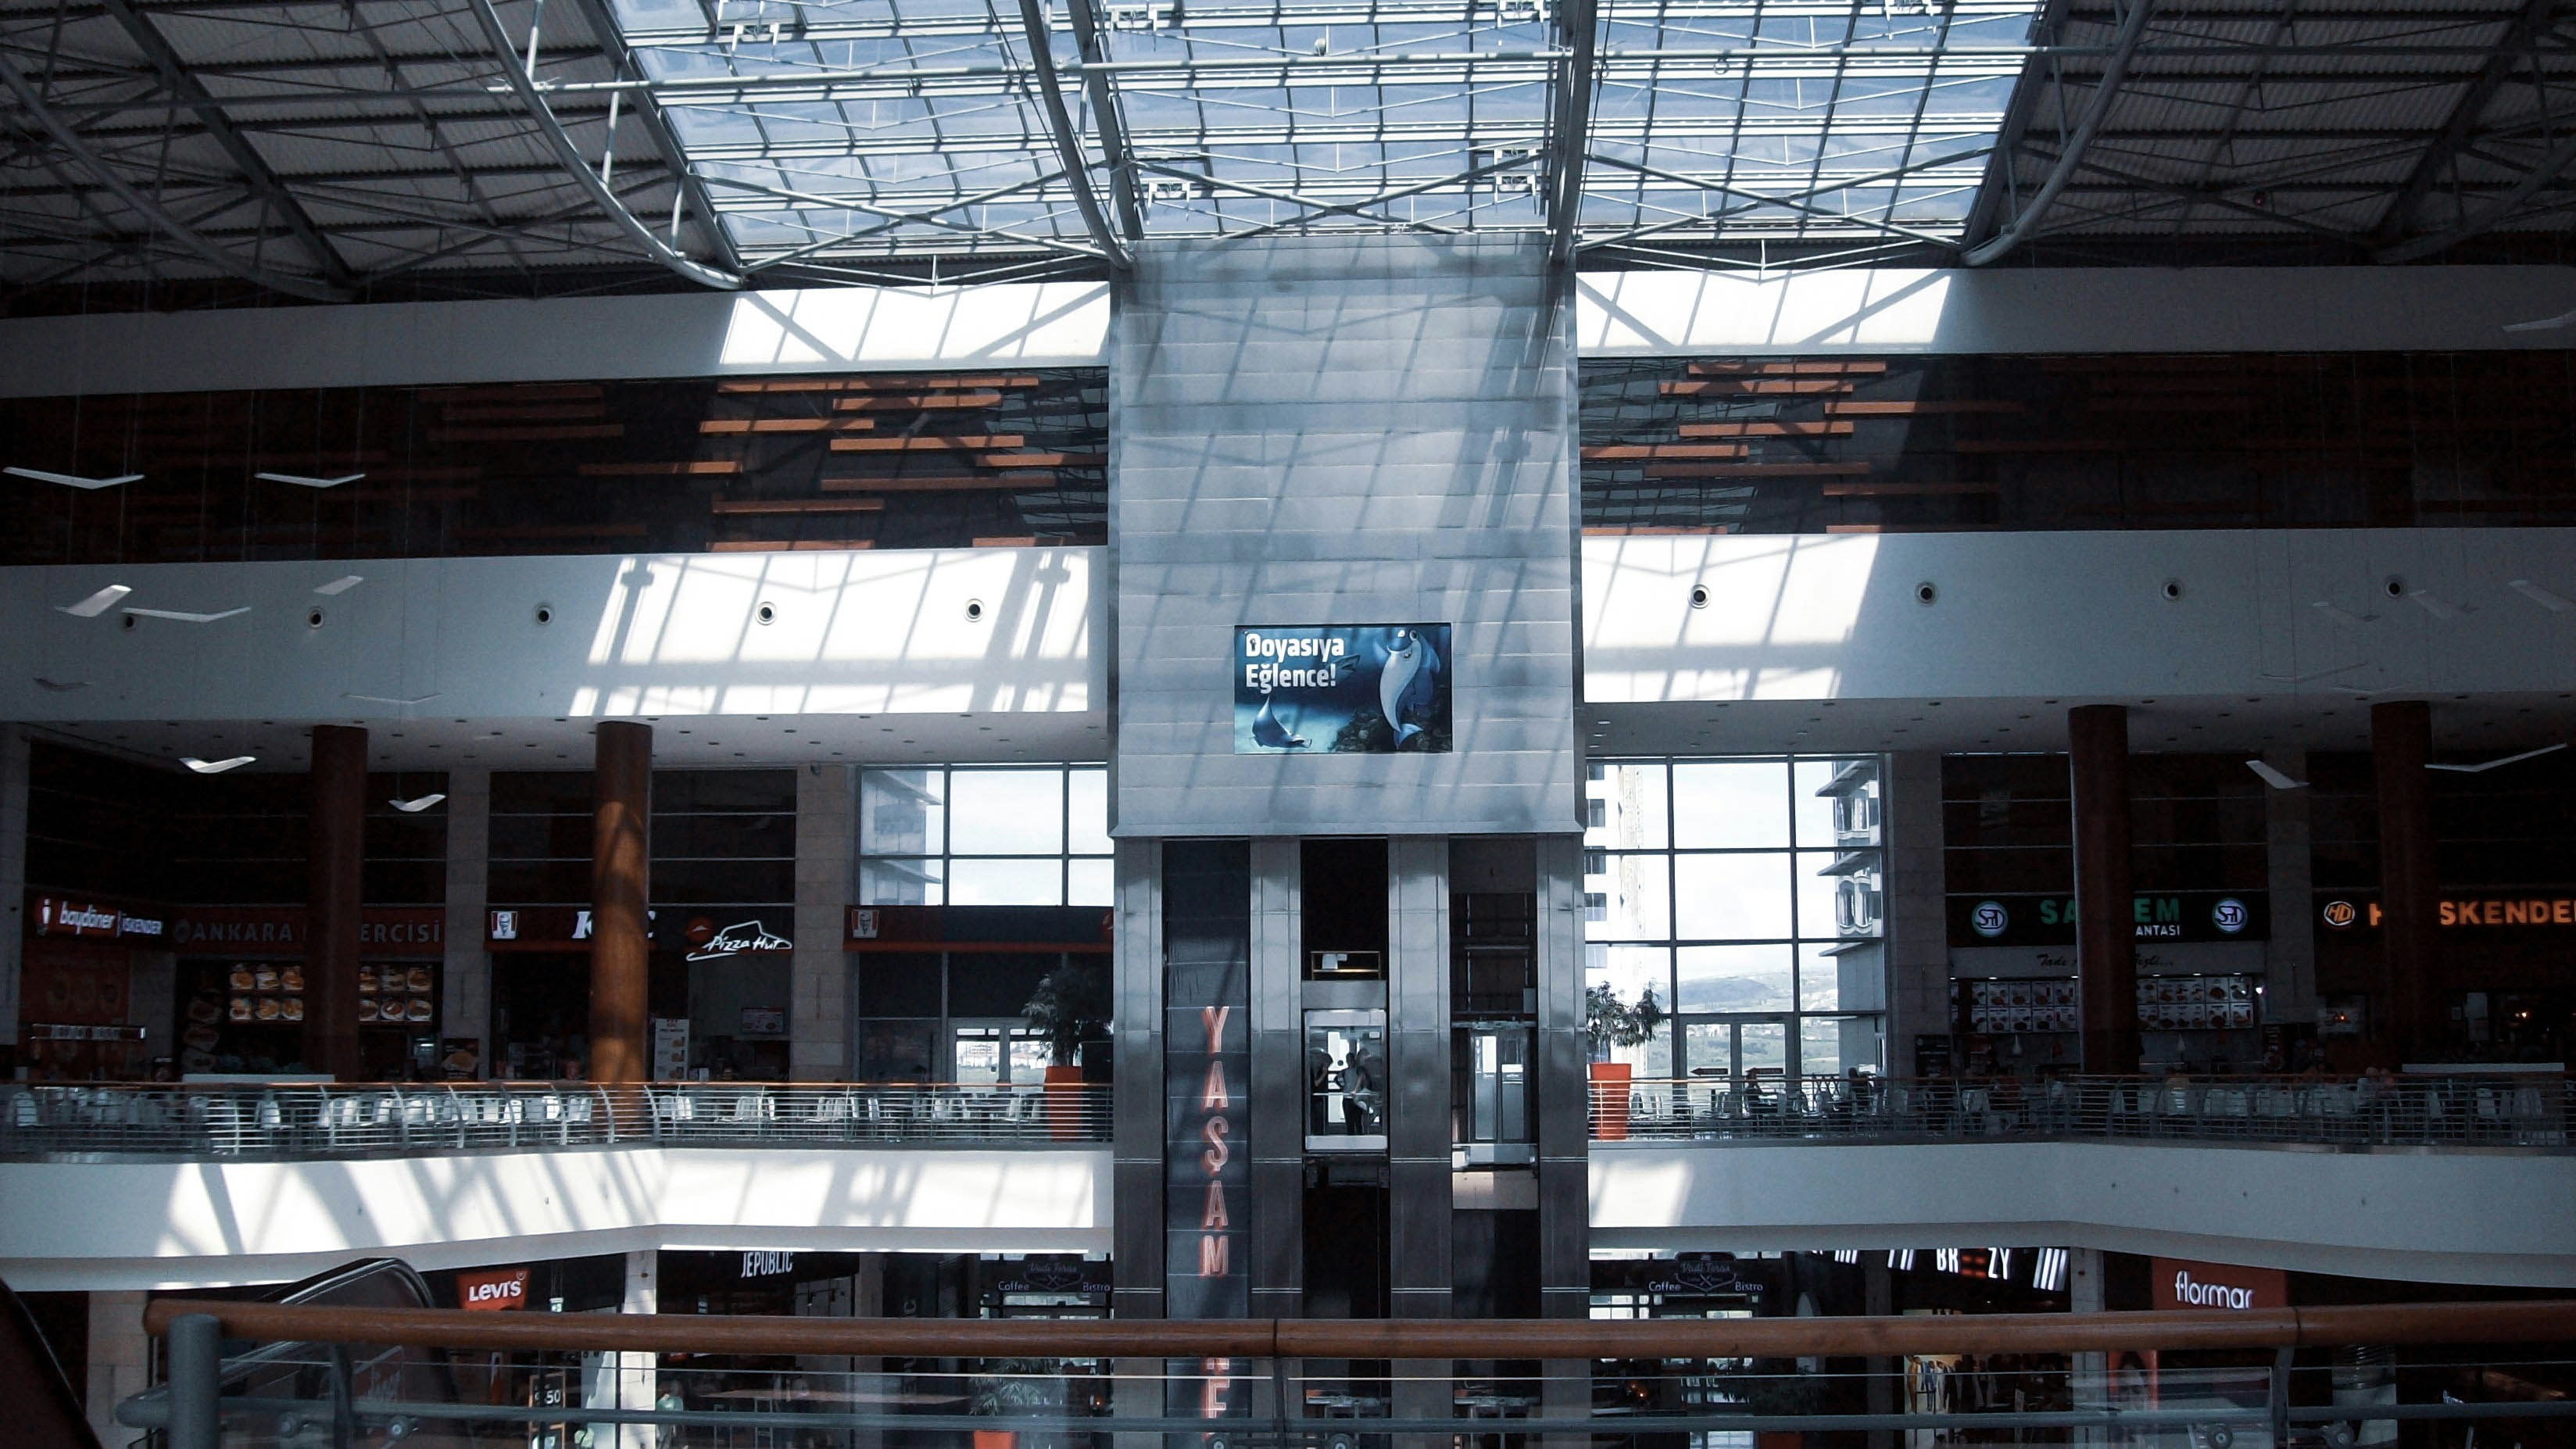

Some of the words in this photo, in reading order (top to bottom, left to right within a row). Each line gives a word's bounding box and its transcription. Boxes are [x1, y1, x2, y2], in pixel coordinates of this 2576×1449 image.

[1246, 633, 1344, 663] Doyasıya
[1246, 664, 1336, 694] Eğlence!
[2038, 898, 2180, 925] SAEM
[192, 921, 293, 943] ANKARA
[2134, 925, 2182, 937] ANTASI
[702, 936, 750, 952] Pizza
[751, 936, 783, 951] Hut
[1203, 1005, 1229, 1275] YAŞAM
[997, 1280, 1030, 1292] Coffee
[1082, 1281, 1111, 1292] Bistro
[1648, 1280, 1681, 1293] Coffee
[1734, 1280, 1764, 1292] Bistro
[2175, 1270, 2256, 1309] flormar
